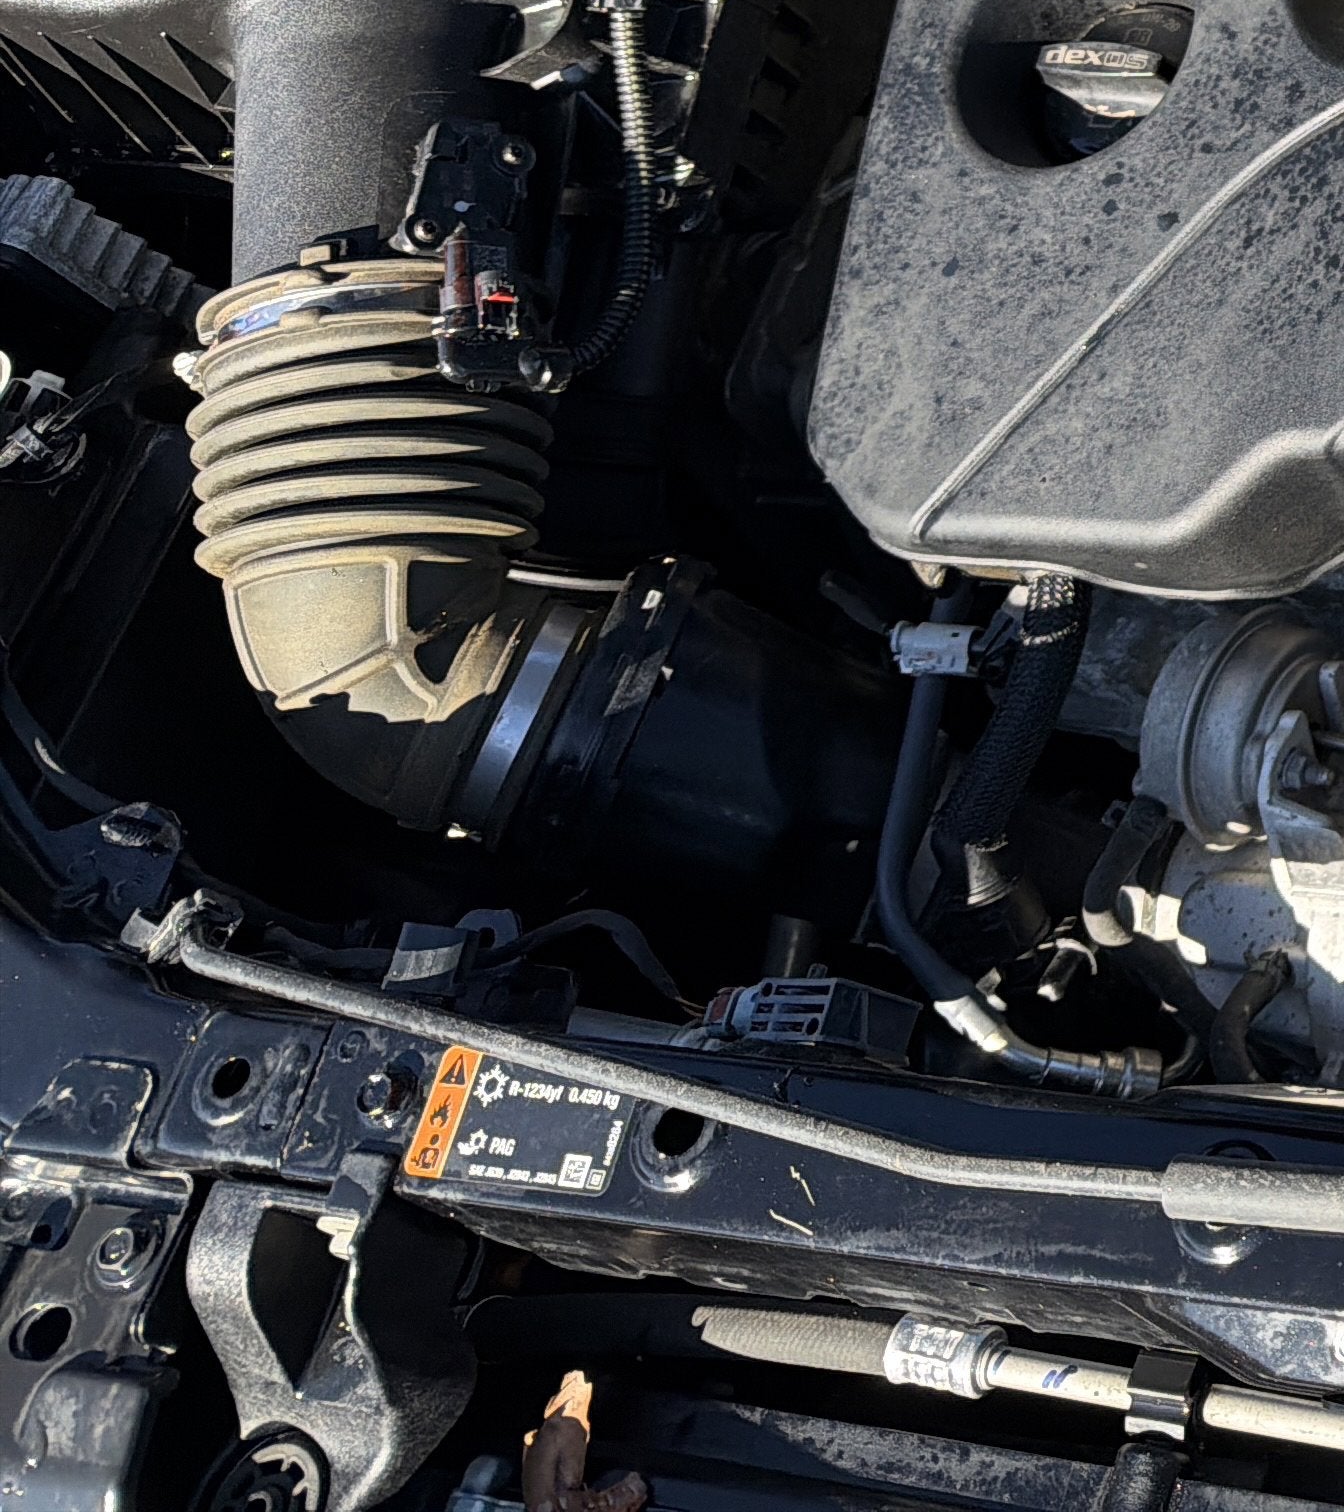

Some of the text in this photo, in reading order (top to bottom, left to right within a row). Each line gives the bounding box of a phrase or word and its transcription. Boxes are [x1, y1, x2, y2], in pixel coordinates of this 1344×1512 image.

[1045, 45, 1150, 70] dexos
[508, 1080, 620, 1110] R-1234yf 0.450 kg
[489, 1137, 516, 1156] PAG
